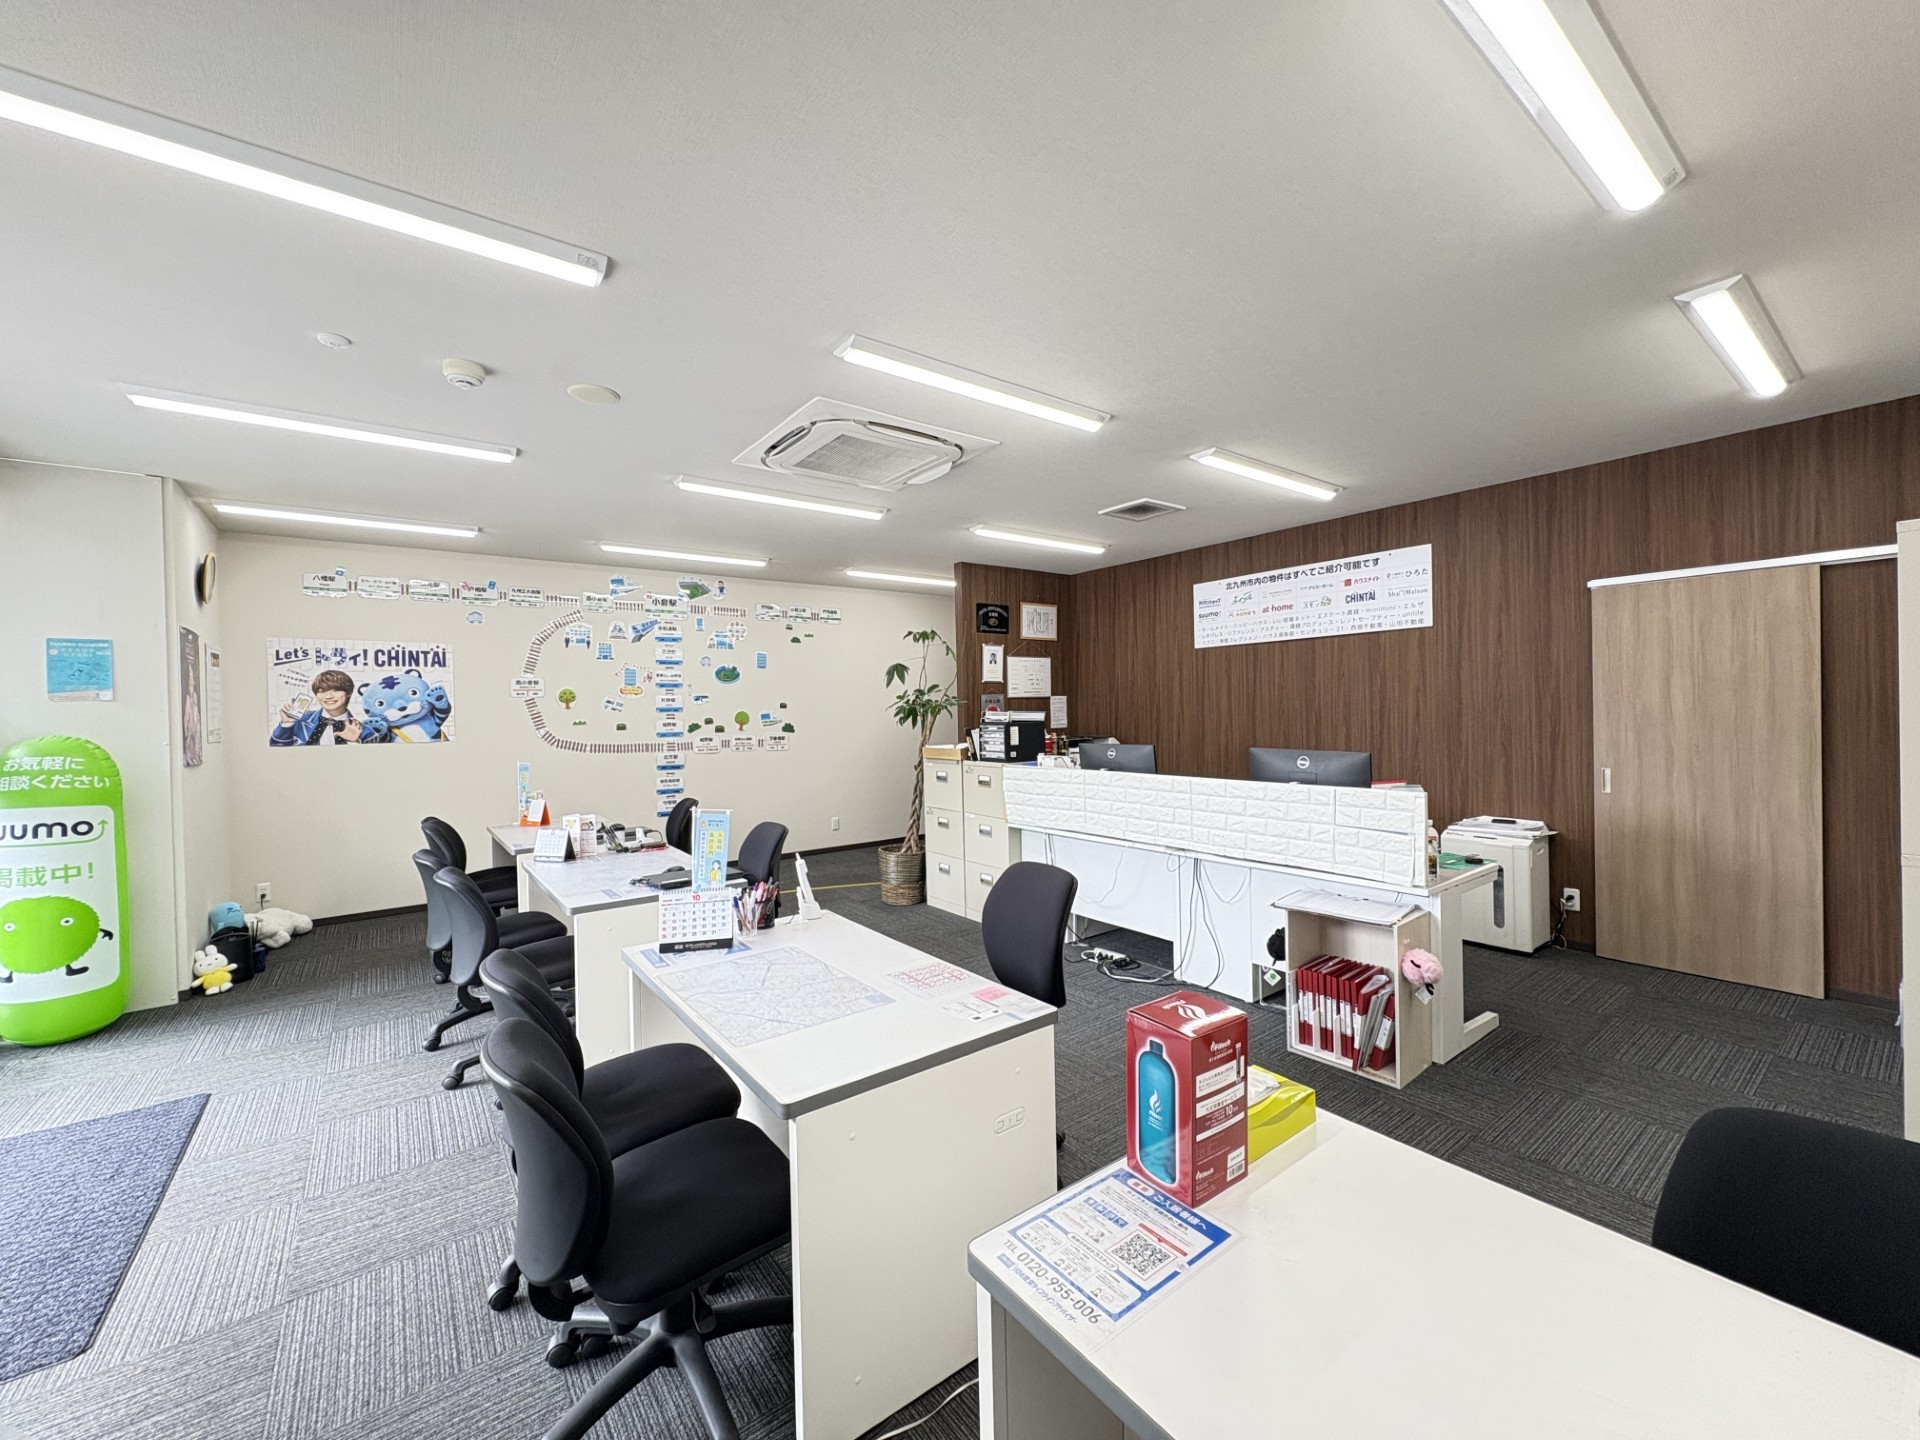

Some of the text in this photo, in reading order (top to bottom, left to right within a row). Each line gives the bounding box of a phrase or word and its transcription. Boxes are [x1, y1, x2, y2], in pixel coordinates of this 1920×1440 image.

[1225, 557, 1381, 591] 北九州市内の物件はすべてご紹介可能です
[652, 598, 677, 607] 小倉駅
[1345, 589, 1376, 604] CHINTAI
[1262, 603, 1294, 613] at home
[275, 647, 310, 661] Let's
[374, 646, 447, 668] CHINTAI
[3, 756, 85, 771] お気軽に
[692, 894, 700, 902] 10
[1153, 1193, 1207, 1231] ご入居者様へ
[1002, 1239, 1017, 1255] TEL
[1017, 1251, 1102, 1325] 0120-955-006
